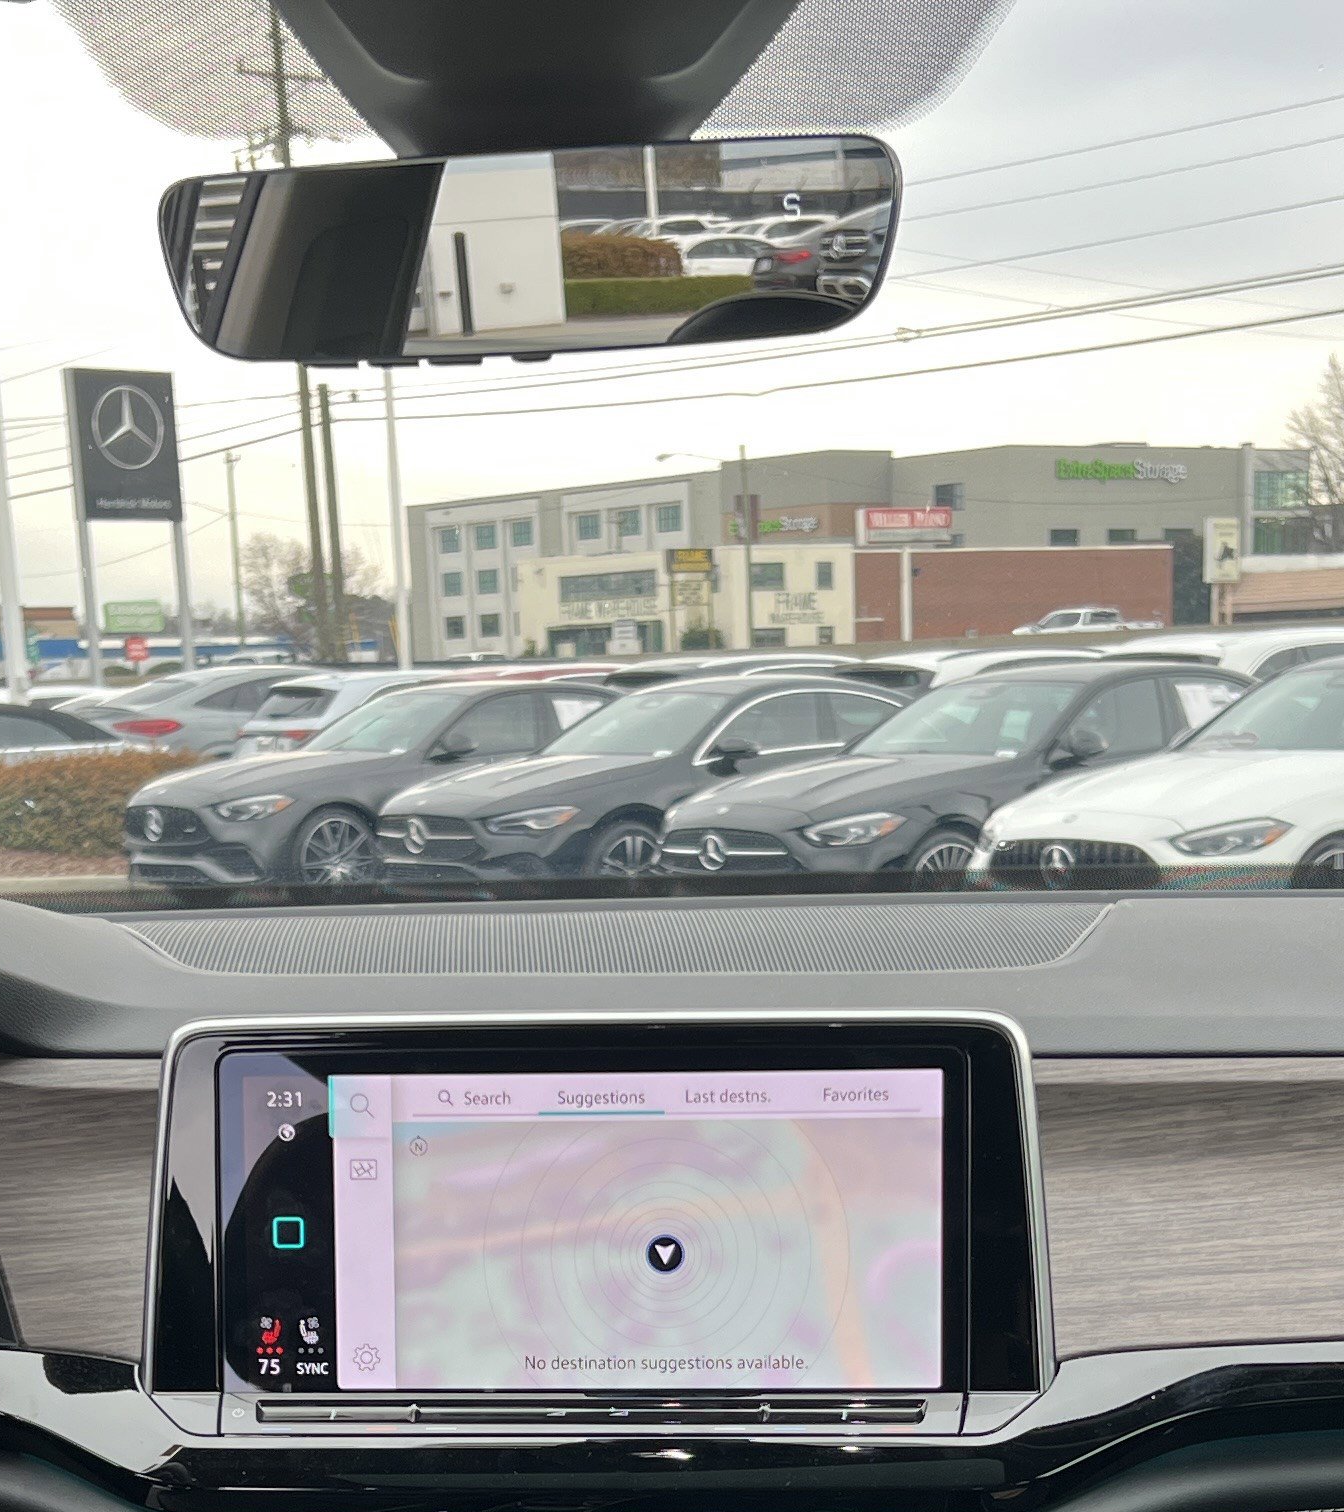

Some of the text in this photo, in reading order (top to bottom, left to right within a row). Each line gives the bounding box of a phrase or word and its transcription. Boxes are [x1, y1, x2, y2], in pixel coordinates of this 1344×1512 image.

[266, 1091, 303, 1108] 2:31
[463, 1087, 890, 1109] Search Suggestions Last destns. Favorites
[258, 1358, 329, 1375] 75 SYNC
[524, 1354, 809, 1374] No destination suggestions available.
